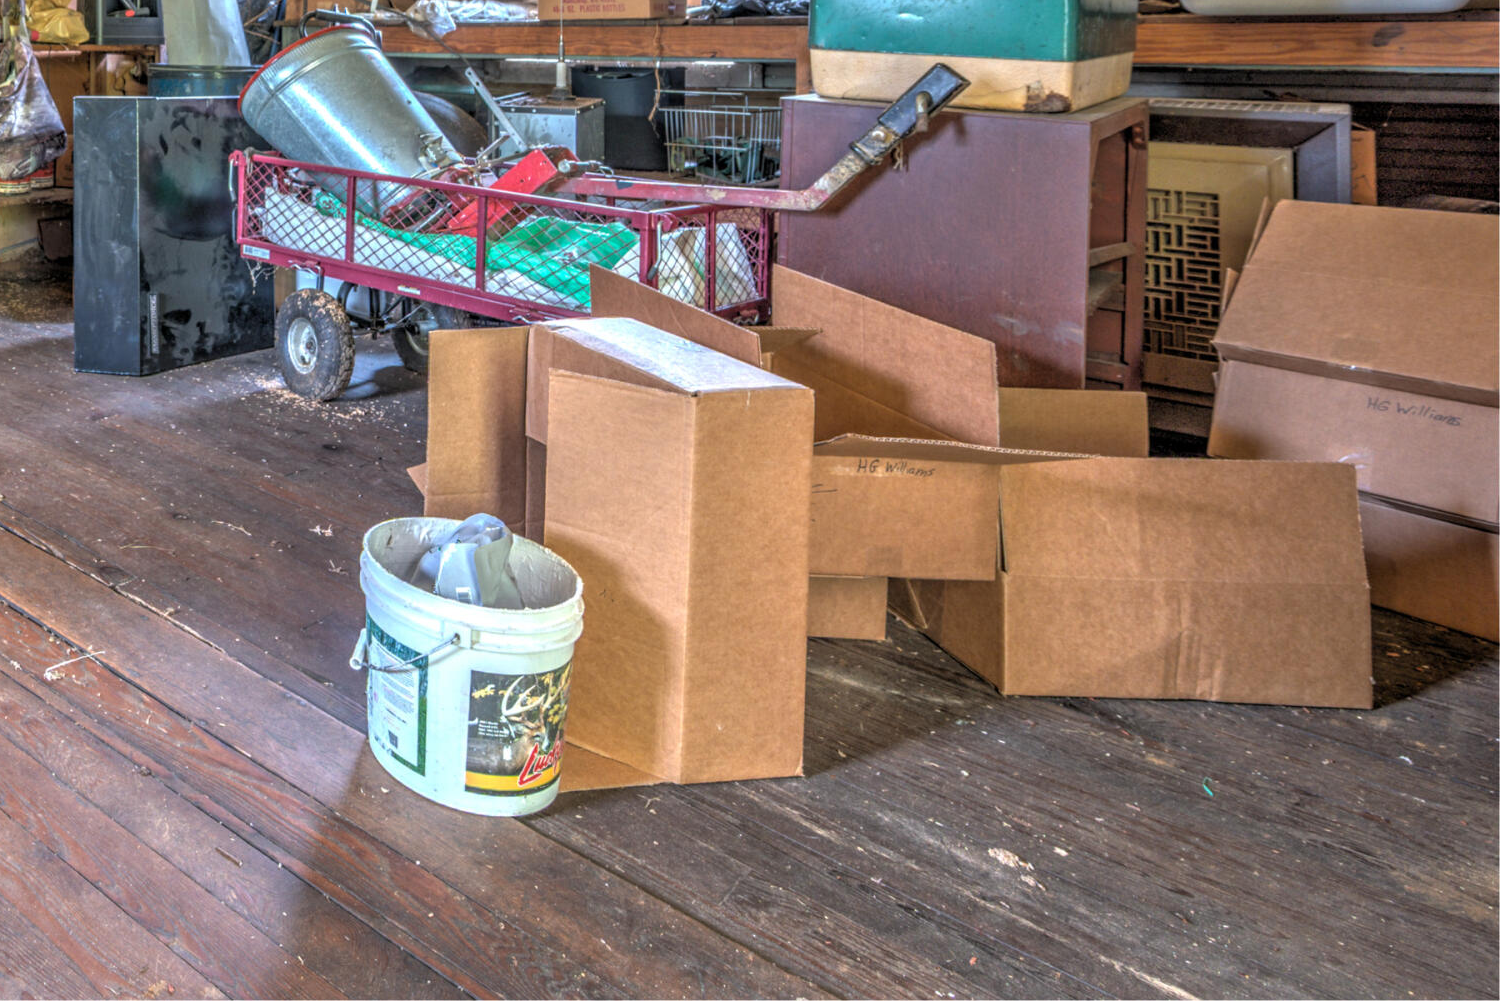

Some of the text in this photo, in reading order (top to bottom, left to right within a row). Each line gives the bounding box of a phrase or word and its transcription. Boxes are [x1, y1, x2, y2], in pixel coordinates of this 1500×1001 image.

[1366, 397, 1462, 426] HG Williams
[857, 457, 936, 477] HG Williams
